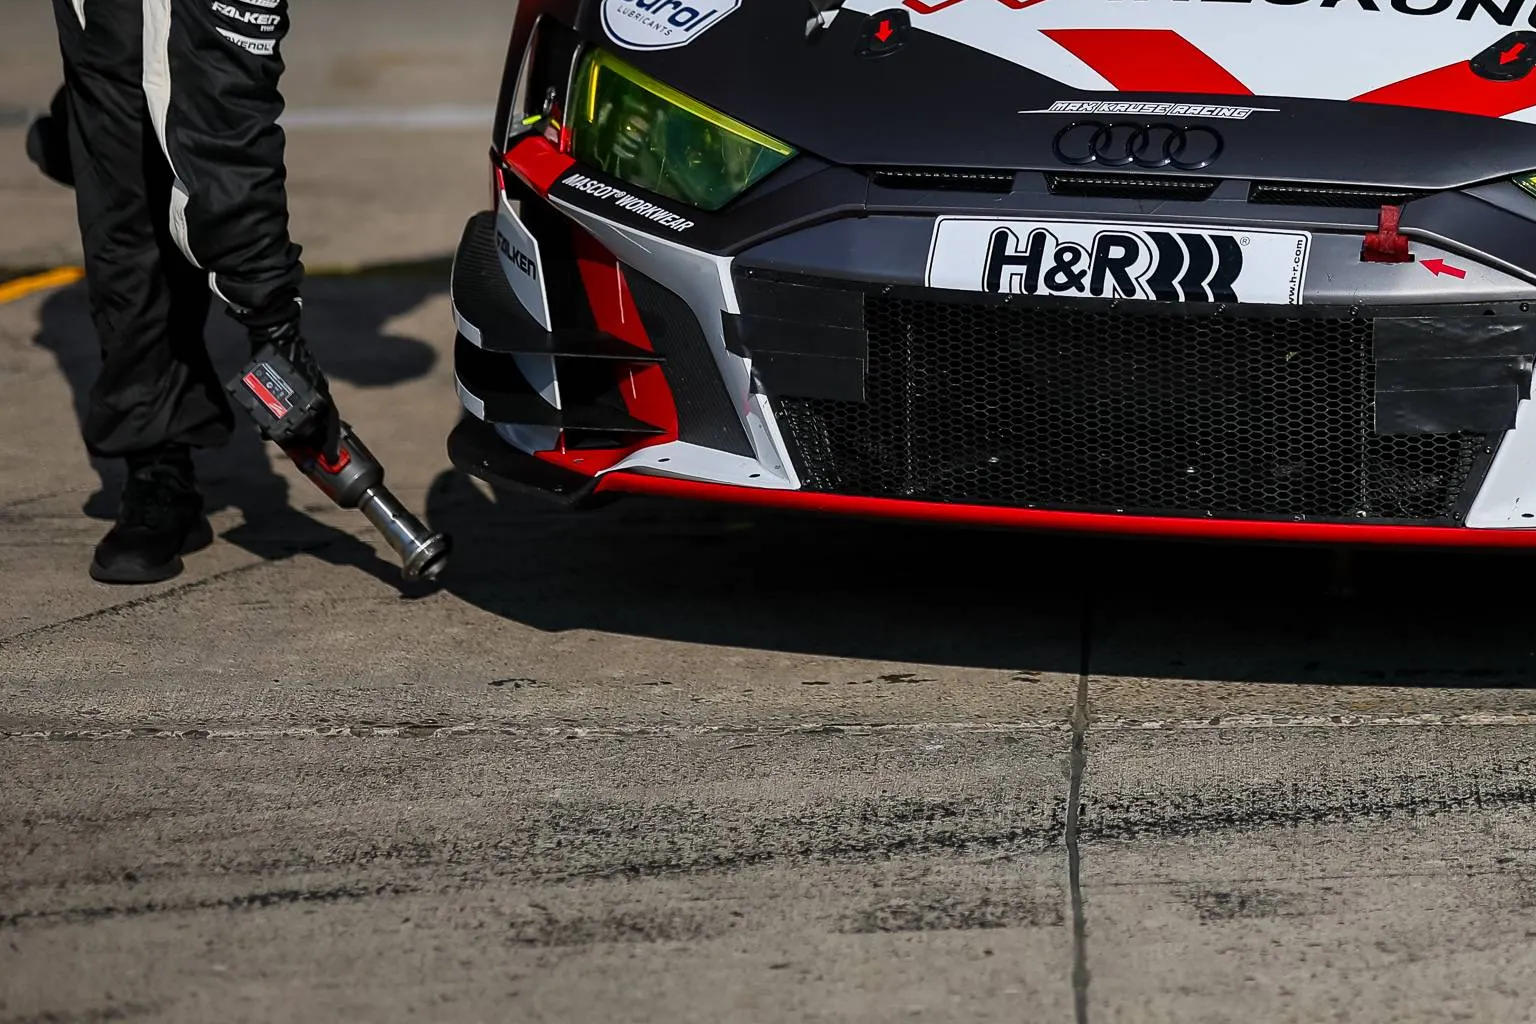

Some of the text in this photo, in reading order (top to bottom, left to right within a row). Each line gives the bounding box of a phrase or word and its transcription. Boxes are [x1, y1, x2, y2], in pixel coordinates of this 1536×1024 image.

[212, 1, 281, 25] FALKEN
[617, 5, 673, 37] LUBRICANTS
[1050, 102, 1253, 119] MAX KRUSE RACING
[617, 193, 695, 232] WORKWEAR
[496, 232, 537, 281] FALKEN
[985, 228, 1148, 298] H&R
